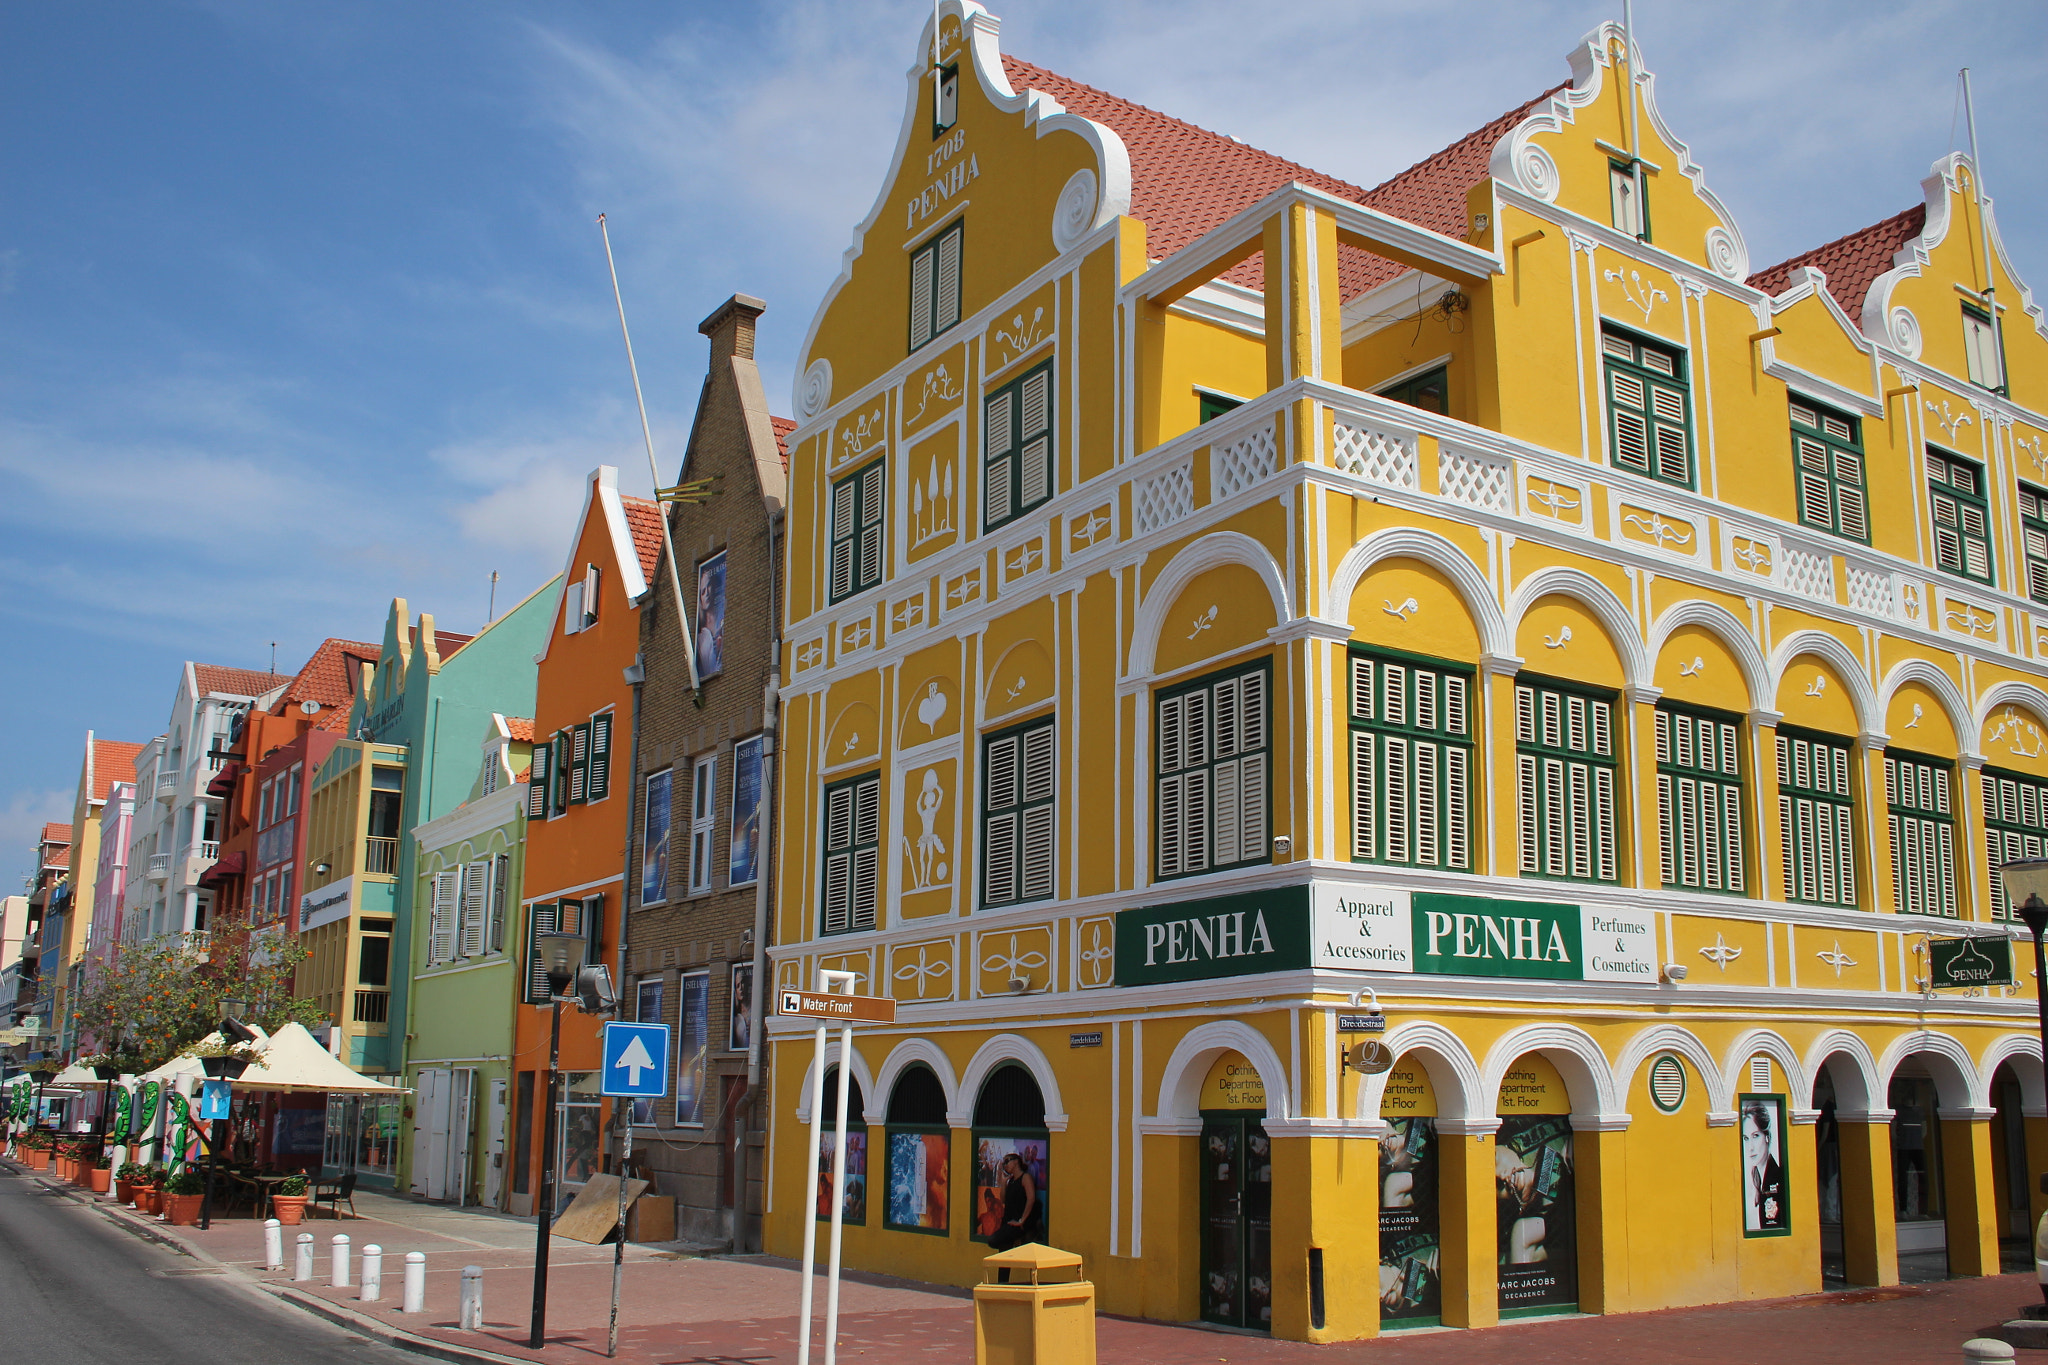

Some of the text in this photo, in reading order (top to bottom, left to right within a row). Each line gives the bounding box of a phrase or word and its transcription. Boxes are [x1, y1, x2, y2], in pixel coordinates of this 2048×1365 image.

[926, 129, 965, 177] 1708
[906, 151, 980, 231] PENHA
[1335, 896, 1394, 918] Apparel
[1359, 919, 1372, 937] &
[1591, 916, 1646, 935] Perfumes
[1144, 908, 1275, 966] PENHA
[1425, 911, 1571, 963] PENHA
[1614, 937, 1626, 952] &
[1322, 940, 1406, 962] Accessories
[1591, 955, 1650, 974] Cosmetics
[1953, 969, 1991, 981] PENHA
[803, 997, 853, 1014] Water Front
[1341, 1018, 1384, 1029] Breedestraat
[1503, 1069, 1536, 1083] lothing
[1384, 1084, 1424, 1095] artment
[1500, 1084, 1546, 1096] epartment
[1226, 1092, 1264, 1104] 1st. Floor
[1392, 1097, 1417, 1109] Floor
[1501, 1096, 1540, 1107] 1st. Floor
[1521, 1277, 1556, 1288] JACOBS
[1505, 1290, 1546, 1300] DECADENCE
